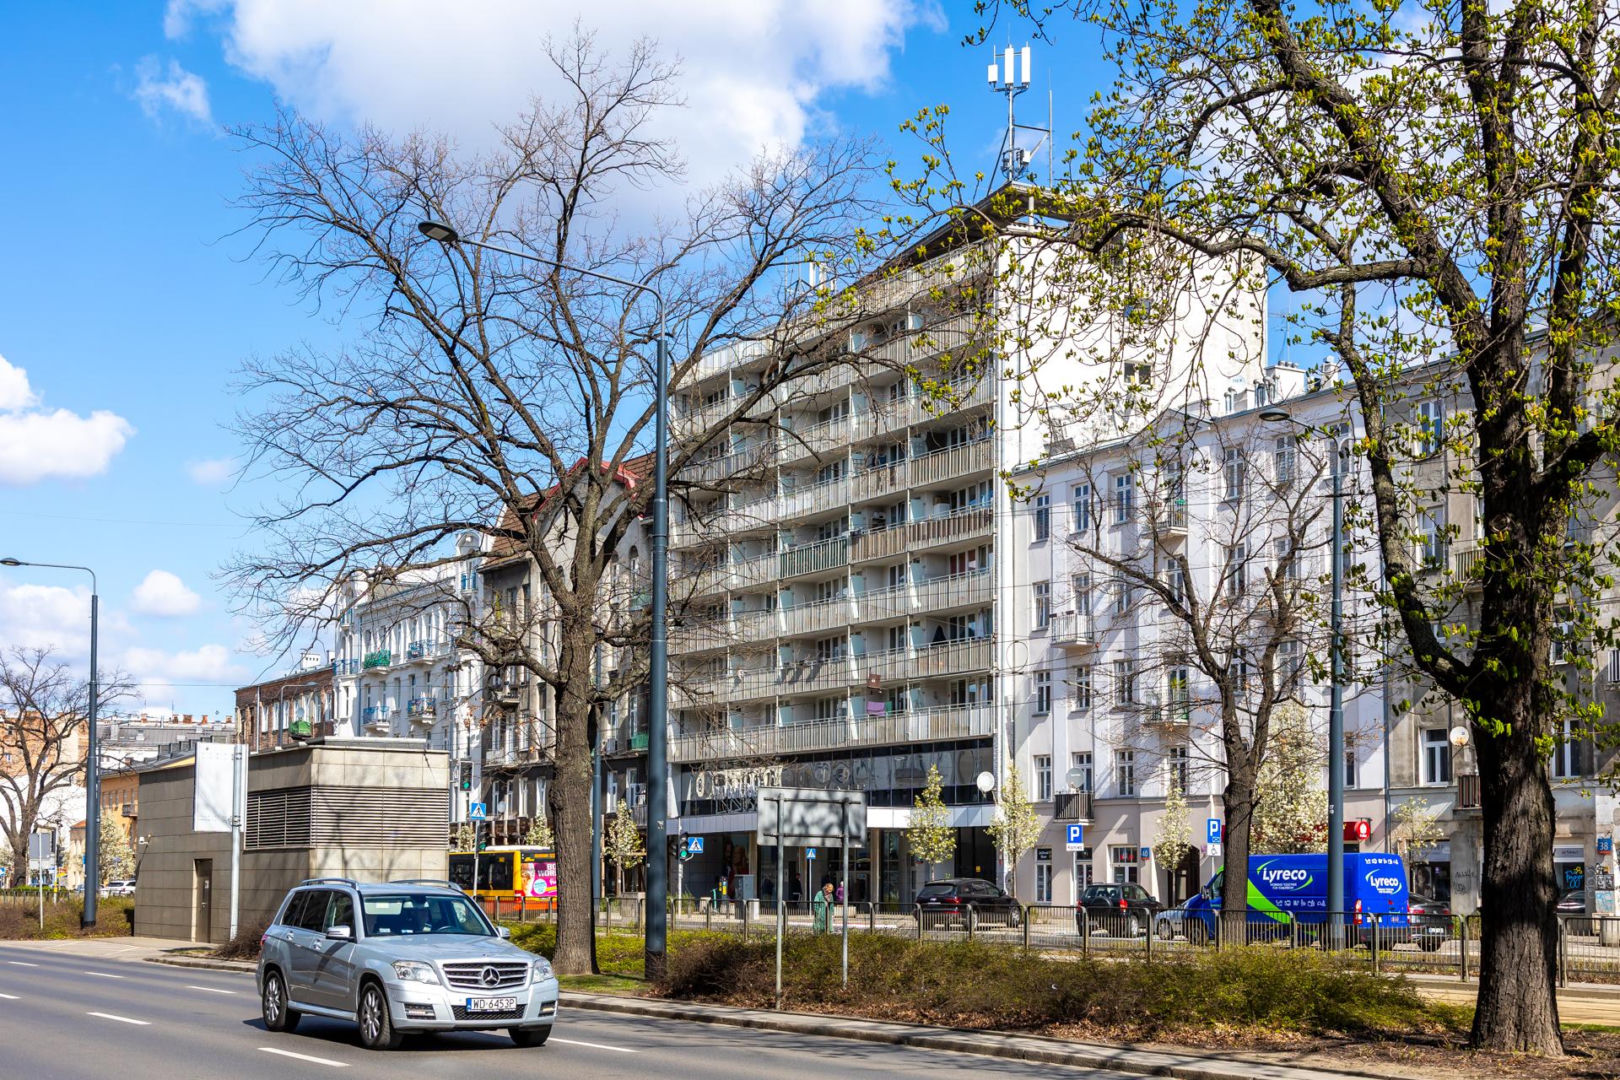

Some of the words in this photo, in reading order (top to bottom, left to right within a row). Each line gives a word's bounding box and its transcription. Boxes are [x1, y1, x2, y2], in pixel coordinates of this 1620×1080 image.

[1071, 826, 1080, 841] P
[1210, 821, 1219, 837] P
[1600, 842, 1609, 850] 38
[1263, 868, 1307, 883] Lyreco
[1370, 875, 1399, 889] Lyreco
